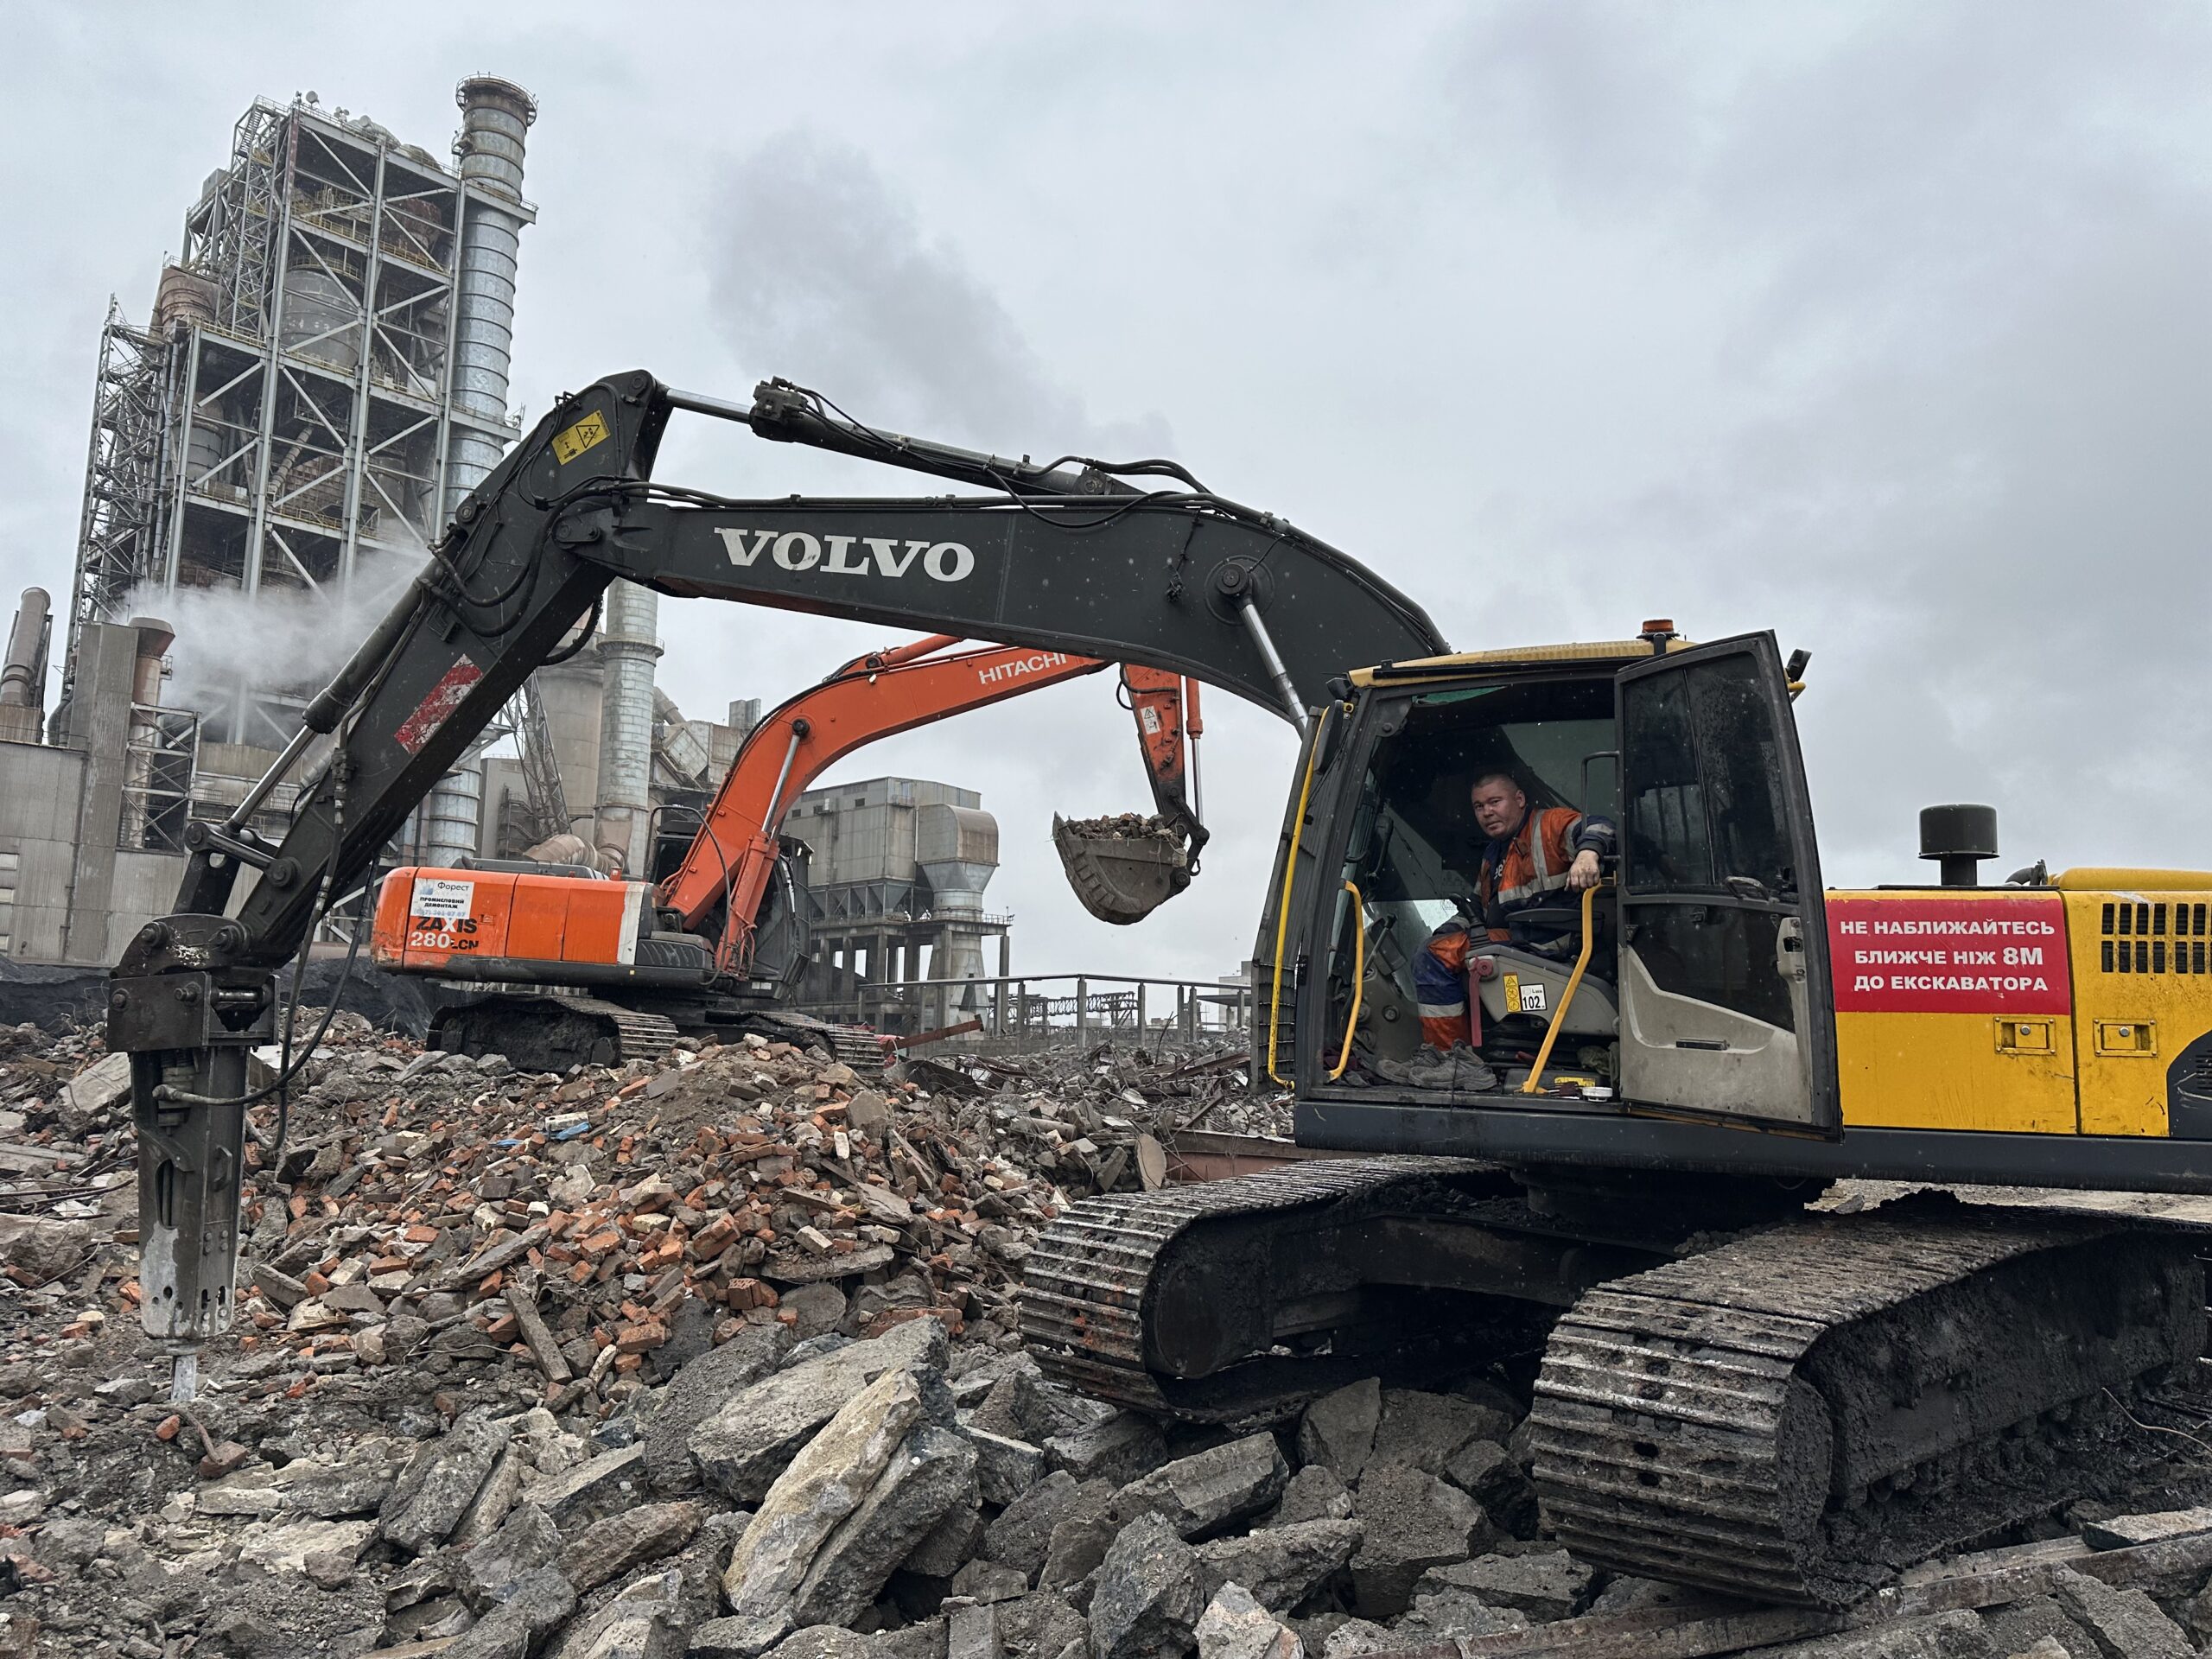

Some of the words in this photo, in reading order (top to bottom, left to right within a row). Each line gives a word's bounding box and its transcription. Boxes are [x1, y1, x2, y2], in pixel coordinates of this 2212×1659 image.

[714, 527, 975, 582] VOLVO
[978, 652, 1067, 684] HITACHI
[437, 881, 470, 891] Форест
[416, 916, 477, 934] ZAXIS
[1840, 921, 1867, 934] НЕ
[1874, 918, 2055, 935] НАБЛИЖАЙТЕСЬ
[1854, 950, 1947, 964] БЛИЖЧЕ
[1954, 950, 1996, 965] НІЖ
[2002, 947, 2044, 965] 8М
[1853, 976, 1885, 991] ДО
[1891, 976, 2048, 991] ЕКСКАВАТОРА
[1522, 995, 1541, 1009] 102
